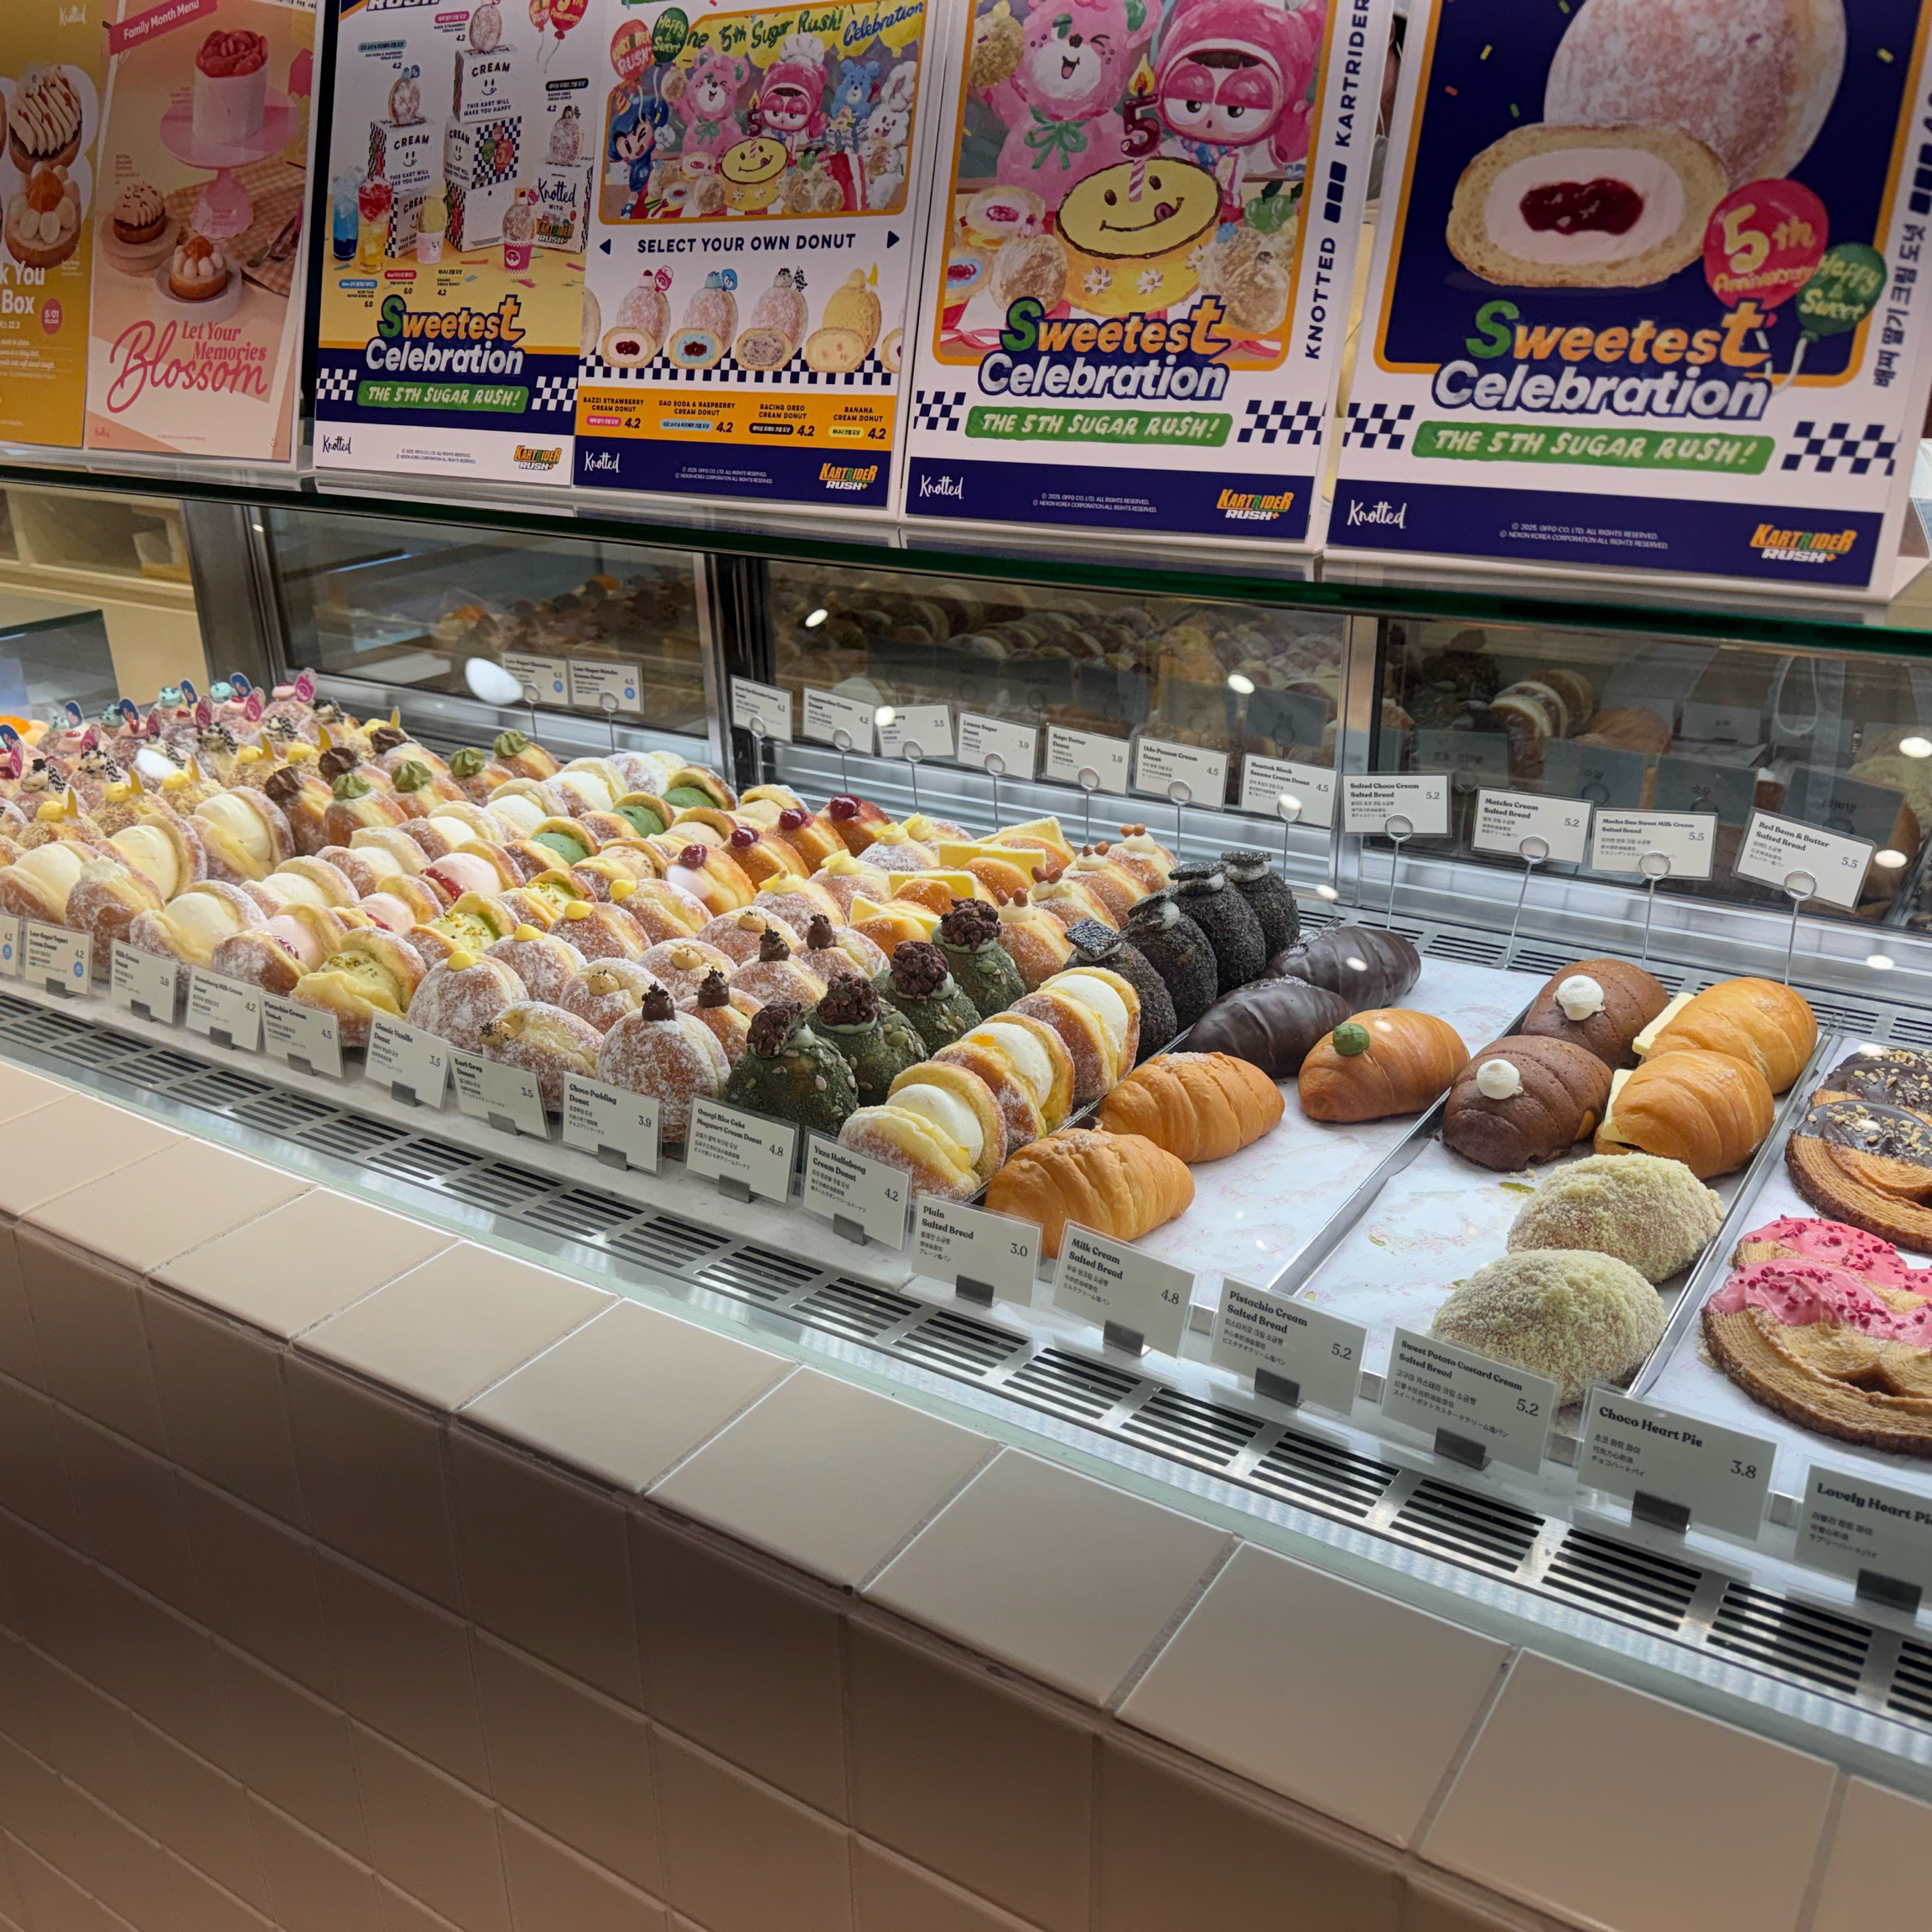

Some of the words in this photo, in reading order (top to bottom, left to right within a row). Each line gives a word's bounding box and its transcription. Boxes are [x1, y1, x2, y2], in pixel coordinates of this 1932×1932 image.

[123, 22, 151, 40] Family
[150, 8, 178, 29] Month
[176, 0, 200, 18] Menu
[472, 62, 510, 77] CREAM
[1335, 0, 1370, 148] KARTRIDER
[394, 135, 429, 150] CREAM
[637, 238, 697, 253] SELECT
[701, 236, 744, 252] YOUR
[750, 236, 789, 251] OWN
[795, 233, 855, 250] DONUT
[1305, 237, 1337, 360] KNOTTED
[377, 295, 526, 343] Sweetest
[1000, 297, 1230, 358] Sweetest
[181, 320, 205, 340] Let
[206, 321, 242, 342] Your
[1465, 299, 1772, 367] Sweetest
[193, 341, 267, 361] Memories
[366, 338, 524, 375] Celebration
[107, 320, 267, 413] Blossom
[979, 352, 1228, 399] Celebration
[368, 387, 392, 402] THE
[394, 387, 422, 402] 5TH
[424, 387, 470, 404] SUGAR
[473, 388, 521, 407] RUSH!
[1434, 358, 1770, 418] Celebration
[624, 417, 641, 429] 4.2
[715, 421, 733, 433] 4.2
[797, 424, 815, 437] 4.2
[982, 413, 1017, 433] THE
[1022, 414, 1065, 434] 5TH
[1067, 414, 1139, 437] SUGAR
[1144, 416, 1221, 439] RUSH!
[867, 427, 886, 440] 4.2
[1435, 429, 1483, 452] THE
[1487, 431, 1545, 454] 5TH
[1550, 431, 1646, 460] SUGAR
[1654, 437, 1758, 466] RUSH!
[584, 450, 621, 474] Knotted
[818, 463, 879, 484] KARTRIDER
[919, 475, 964, 500] Knotted
[1217, 489, 1295, 513] KARTRIDER
[1347, 499, 1407, 529] Knotted
[1750, 522, 1858, 554] KARTRIDER
[1052, 741, 1070, 750] Donut
[1111, 754, 1124, 764] 3.9
[1143, 753, 1162, 762] Donut
[1177, 752, 1198, 761] Cream
[1206, 766, 1219, 776] 4.5
[1250, 770, 1272, 779] Sesame
[1272, 773, 1291, 782] Cream
[1291, 777, 1311, 787] Donut
[1315, 783, 1329, 793] 4.5
[1426, 791, 1441, 800] 5.2
[1483, 807, 1509, 816] Salted
[1509, 810, 1532, 819] Bread
[1485, 797, 1514, 808] Matcha
[1514, 802, 1540, 811] Cream
[1564, 818, 1581, 828] 5.2
[1688, 831, 1706, 842] 5.5
[1755, 830, 1782, 844] Salted
[1782, 839, 1807, 852] Bread
[1758, 821, 1775, 833] Red
[1775, 826, 1795, 838] Bean
[1803, 835, 1831, 849] Butter
[1841, 856, 1859, 870] 5.5
[245, 1001, 257, 1013] 4.2
[321, 1028, 333, 1041] 4.5
[374, 1031, 391, 1045] Donut
[376, 1021, 394, 1036] Classic
[429, 1054, 441, 1068] 3.5
[454, 1057, 469, 1068] Earl
[468, 1062, 483, 1074] Grey
[456, 1067, 476, 1079] Donut
[521, 1086, 534, 1099] 3.5
[569, 1083, 590, 1096] Choco
[589, 1089, 618, 1106] Pudding
[569, 1093, 590, 1107] Donut
[638, 1114, 652, 1129] 3.9
[698, 1107, 718, 1120] Omegi
[717, 1114, 730, 1124] Rice
[730, 1118, 746, 1130] Cake
[724, 1126, 744, 1140] Cream
[743, 1133, 763, 1146] Donut
[768, 1144, 784, 1158] 4.8
[814, 1145, 831, 1159] Yuza
[831, 1152, 867, 1176] Hallabong
[813, 1157, 835, 1172] Cream
[835, 1166, 857, 1182] Donut
[884, 1187, 900, 1202] 4.2
[923, 1205, 945, 1219] Plain
[921, 1218, 948, 1233] Salted
[948, 1227, 974, 1241] Bread
[1010, 1242, 1028, 1257] 3.0
[1071, 1238, 1091, 1254] Milk
[1092, 1246, 1120, 1265] Cream
[1068, 1250, 1097, 1270] Salted
[1097, 1261, 1124, 1280] Bread
[1161, 1289, 1180, 1306] 4.8
[1229, 1290, 1275, 1315] Pistachio
[1275, 1307, 1308, 1327] Cream
[1227, 1304, 1258, 1323] Salted
[1258, 1315, 1288, 1335] Bread
[1331, 1343, 1353, 1361] 5.2
[1398, 1352, 1426, 1369] Salted
[1426, 1363, 1453, 1379] Bread
[1401, 1340, 1427, 1356] Sweet
[1426, 1349, 1457, 1367] Potato
[1457, 1361, 1493, 1380] Custard
[1493, 1374, 1523, 1392] Cream
[1395, 1368, 1415, 1383] 고구마
[1456, 1391, 1477, 1407] 소금빵
[1515, 1398, 1540, 1418] 5.2
[1599, 1405, 1639, 1428] Choco
[1640, 1419, 1680, 1441] Heart
[1680, 1431, 1703, 1448] Pie
[1729, 1459, 1757, 1479] 3.8
[1816, 1482, 1866, 1509] Lovely
[1867, 1497, 1913, 1519] Heart
